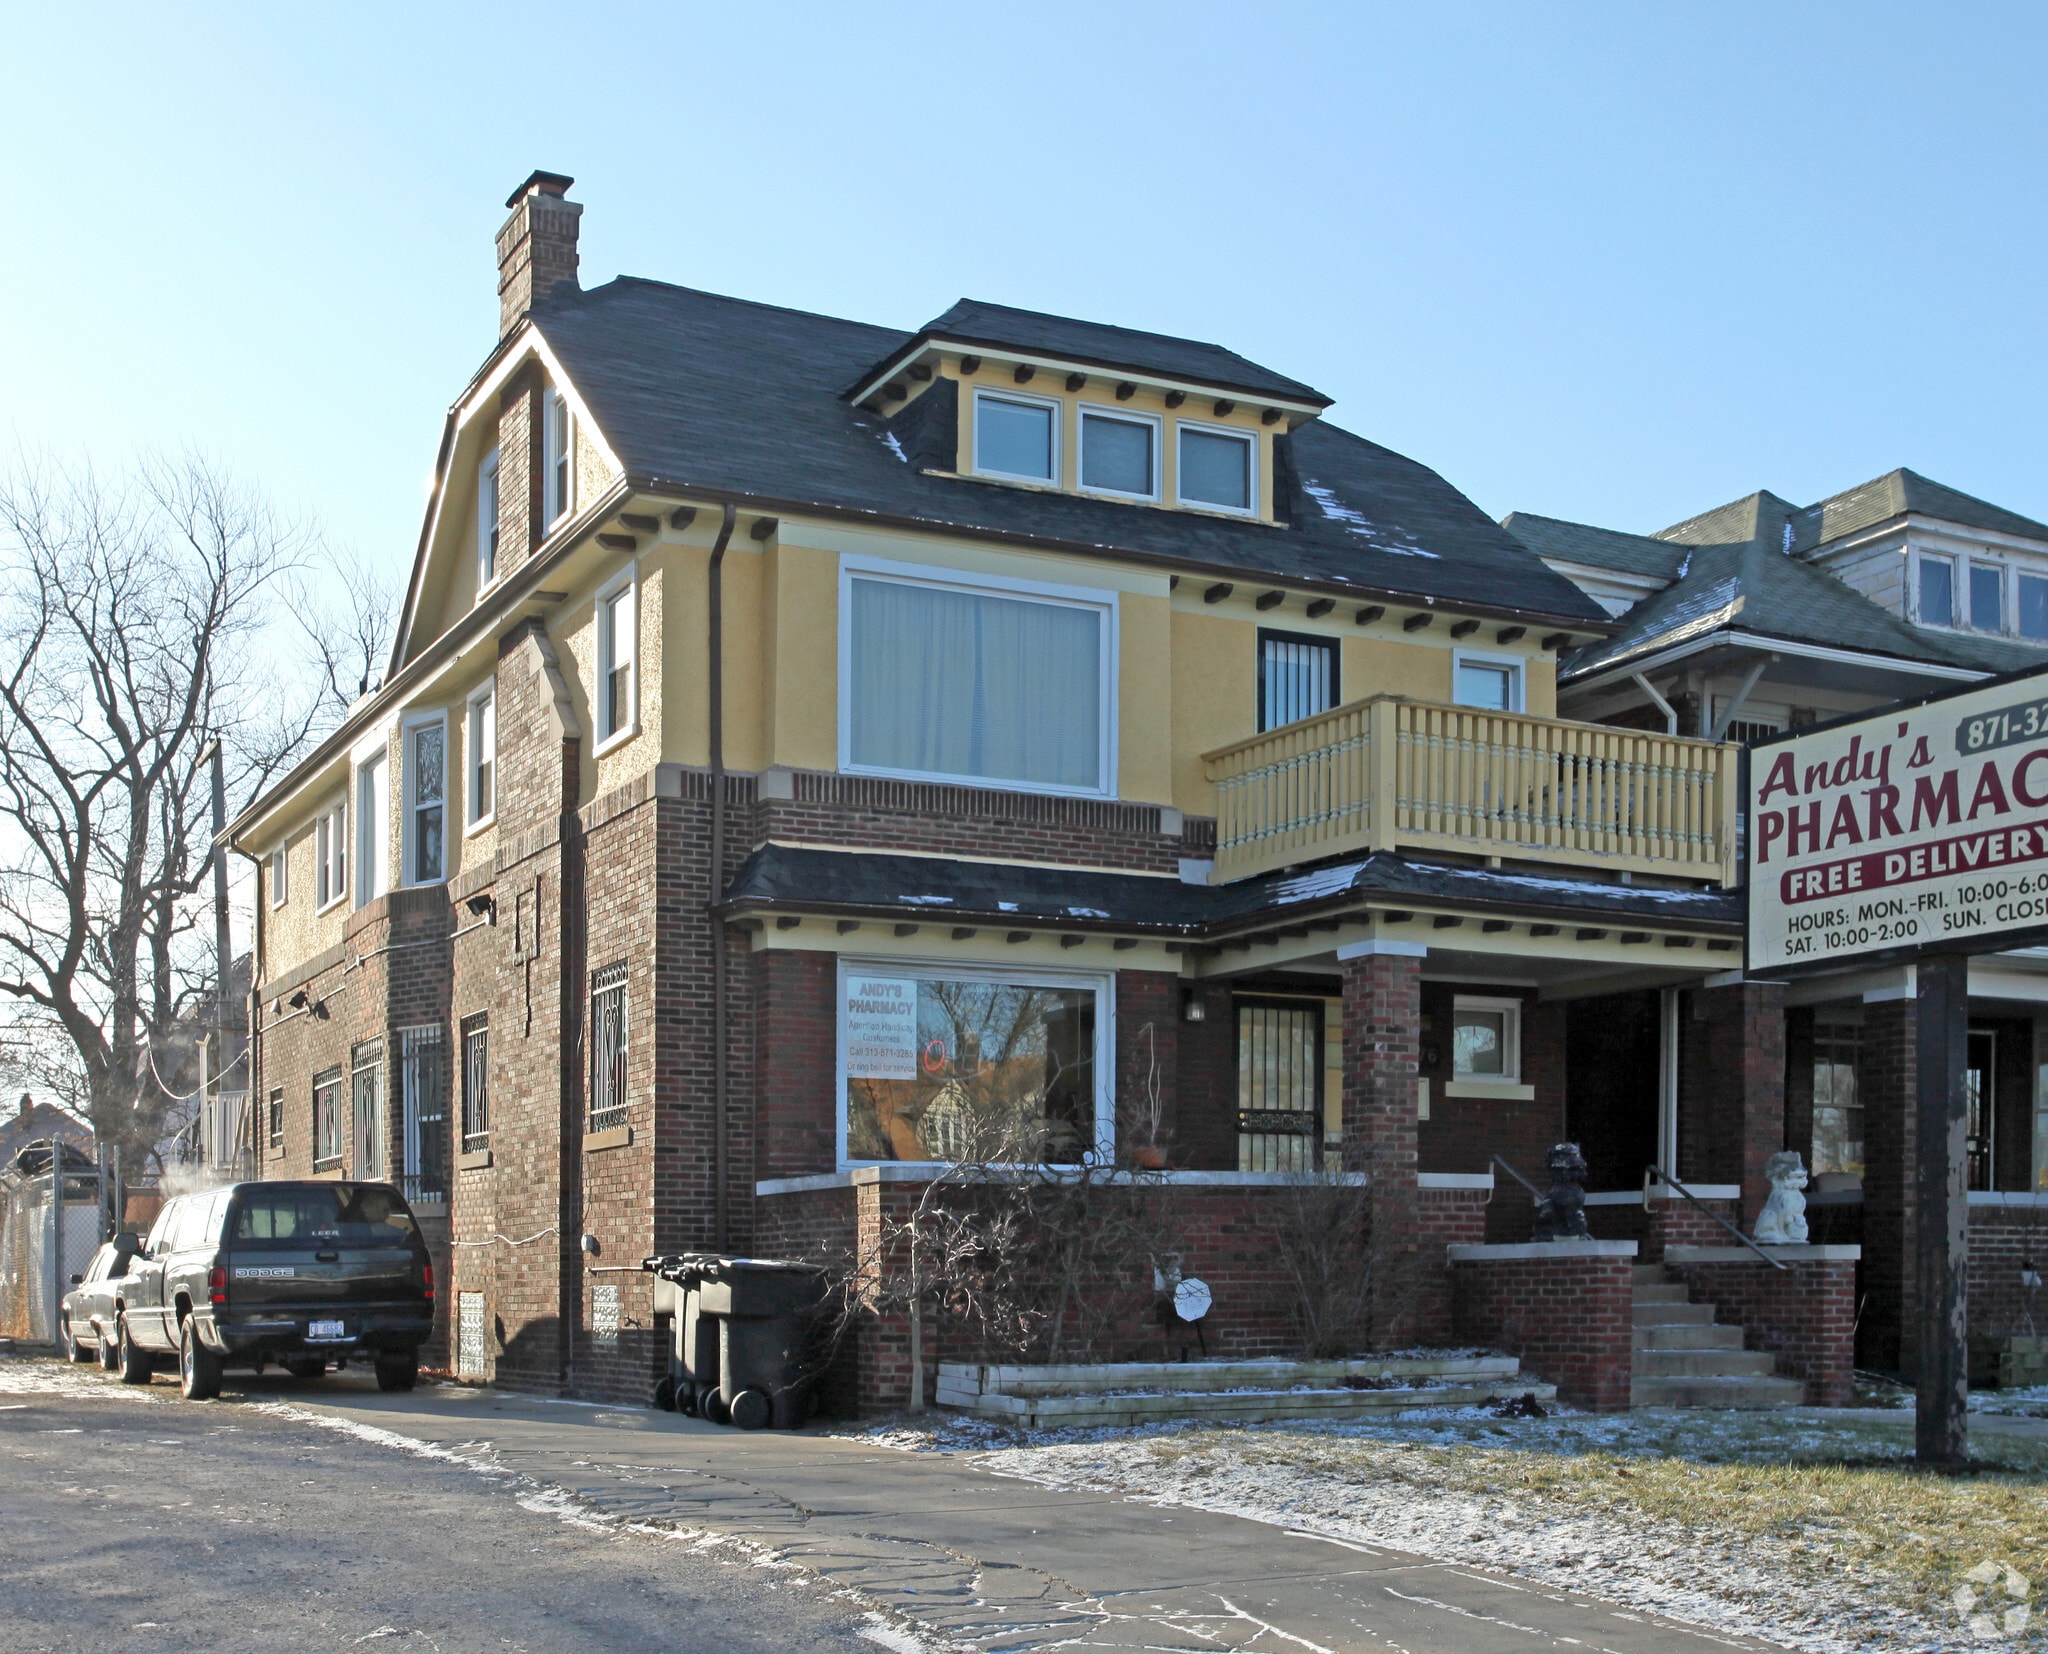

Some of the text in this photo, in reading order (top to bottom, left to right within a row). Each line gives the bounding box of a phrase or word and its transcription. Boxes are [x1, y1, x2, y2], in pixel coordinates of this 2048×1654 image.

[1758, 721, 1936, 806] Andy's
[1757, 748, 2048, 864] PHARMAC
[1790, 862, 1863, 900] FREE
[1788, 909, 1849, 934] HOURS:
[1858, 890, 1949, 922] MON.-FRI.
[1785, 896, 2048, 956] SAT. 10:00-2:00 SUN. CLOS
[859, 982, 903, 999] ANDY'S
[848, 999, 914, 1016] PHARMACY
[850, 1047, 914, 1058] Call 313-871-3285
[857, 1063, 870, 1074] ring
[236, 1267, 295, 1278] DODGE
